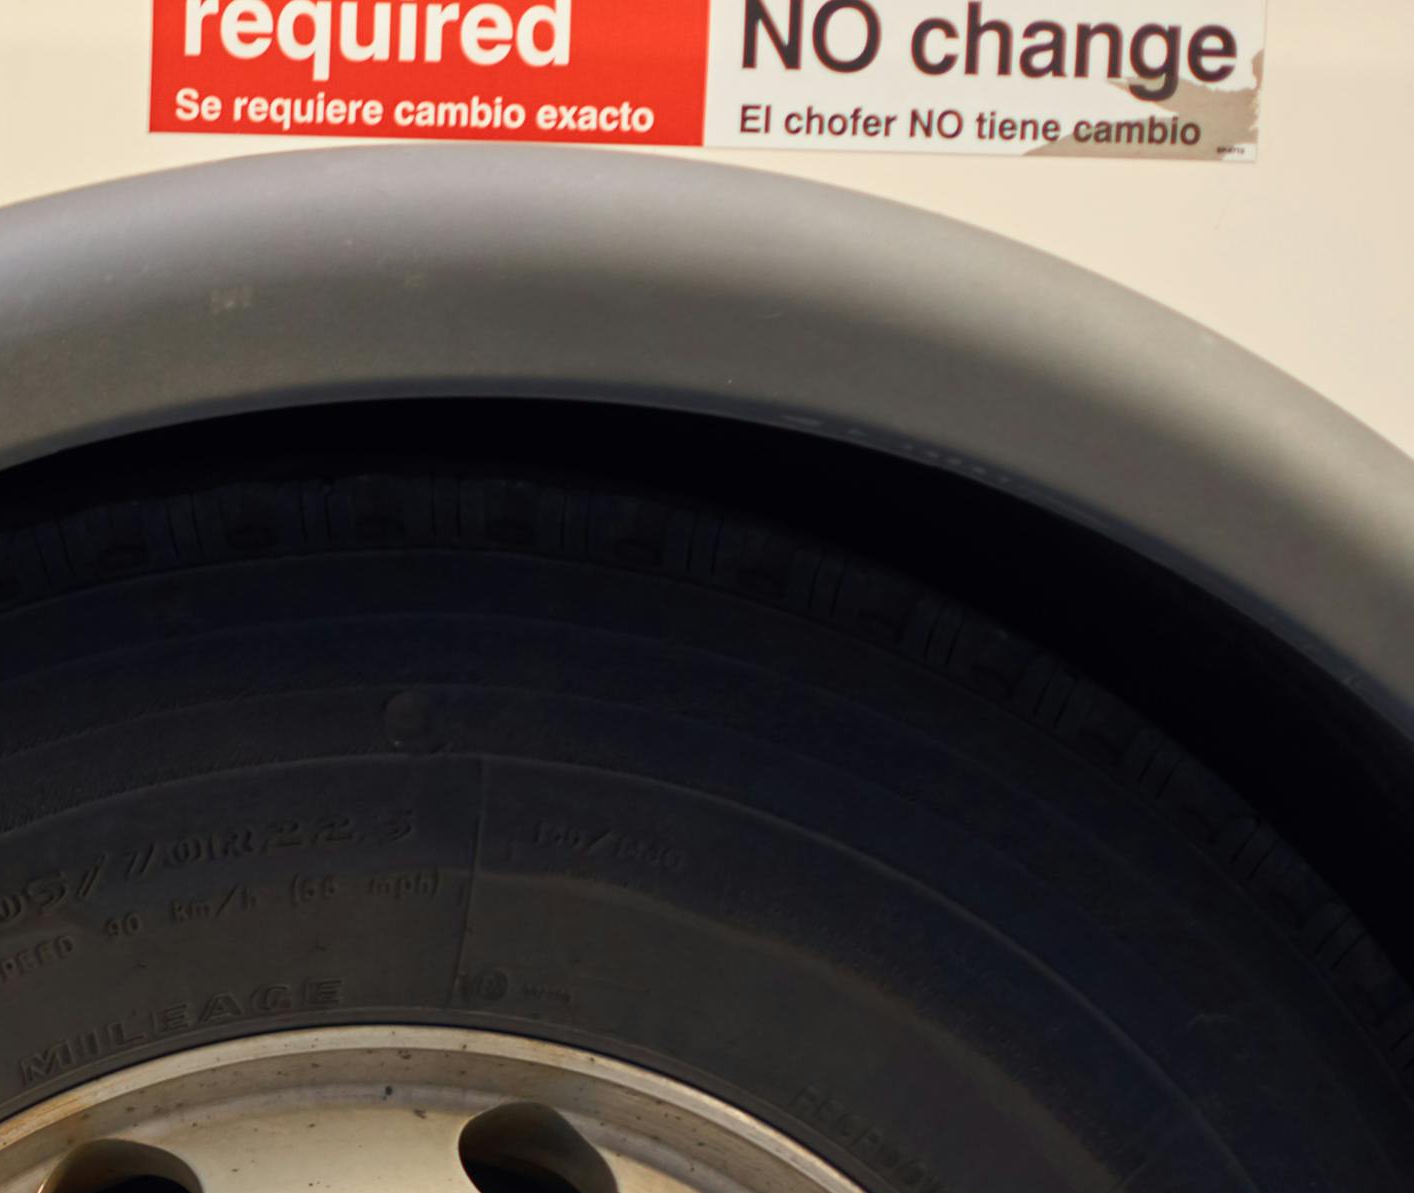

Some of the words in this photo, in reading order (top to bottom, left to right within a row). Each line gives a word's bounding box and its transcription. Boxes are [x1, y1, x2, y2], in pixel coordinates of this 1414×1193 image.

[182, 0, 572, 82] required
[741, 0, 882, 73] NO
[910, 0, 1238, 101] change
[174, 87, 222, 122] Se
[232, 91, 384, 131] requiere
[394, 93, 526, 131] cambio
[535, 99, 656, 133] exacto
[739, 104, 772, 134] El
[784, 106, 897, 138] chofer
[909, 109, 964, 140] NO
[976, 111, 1061, 142] tiene
[1073, 115, 1202, 147] cambio
[100, 912, 145, 942] 90
[15, 978, 345, 1083] MILEAGE
